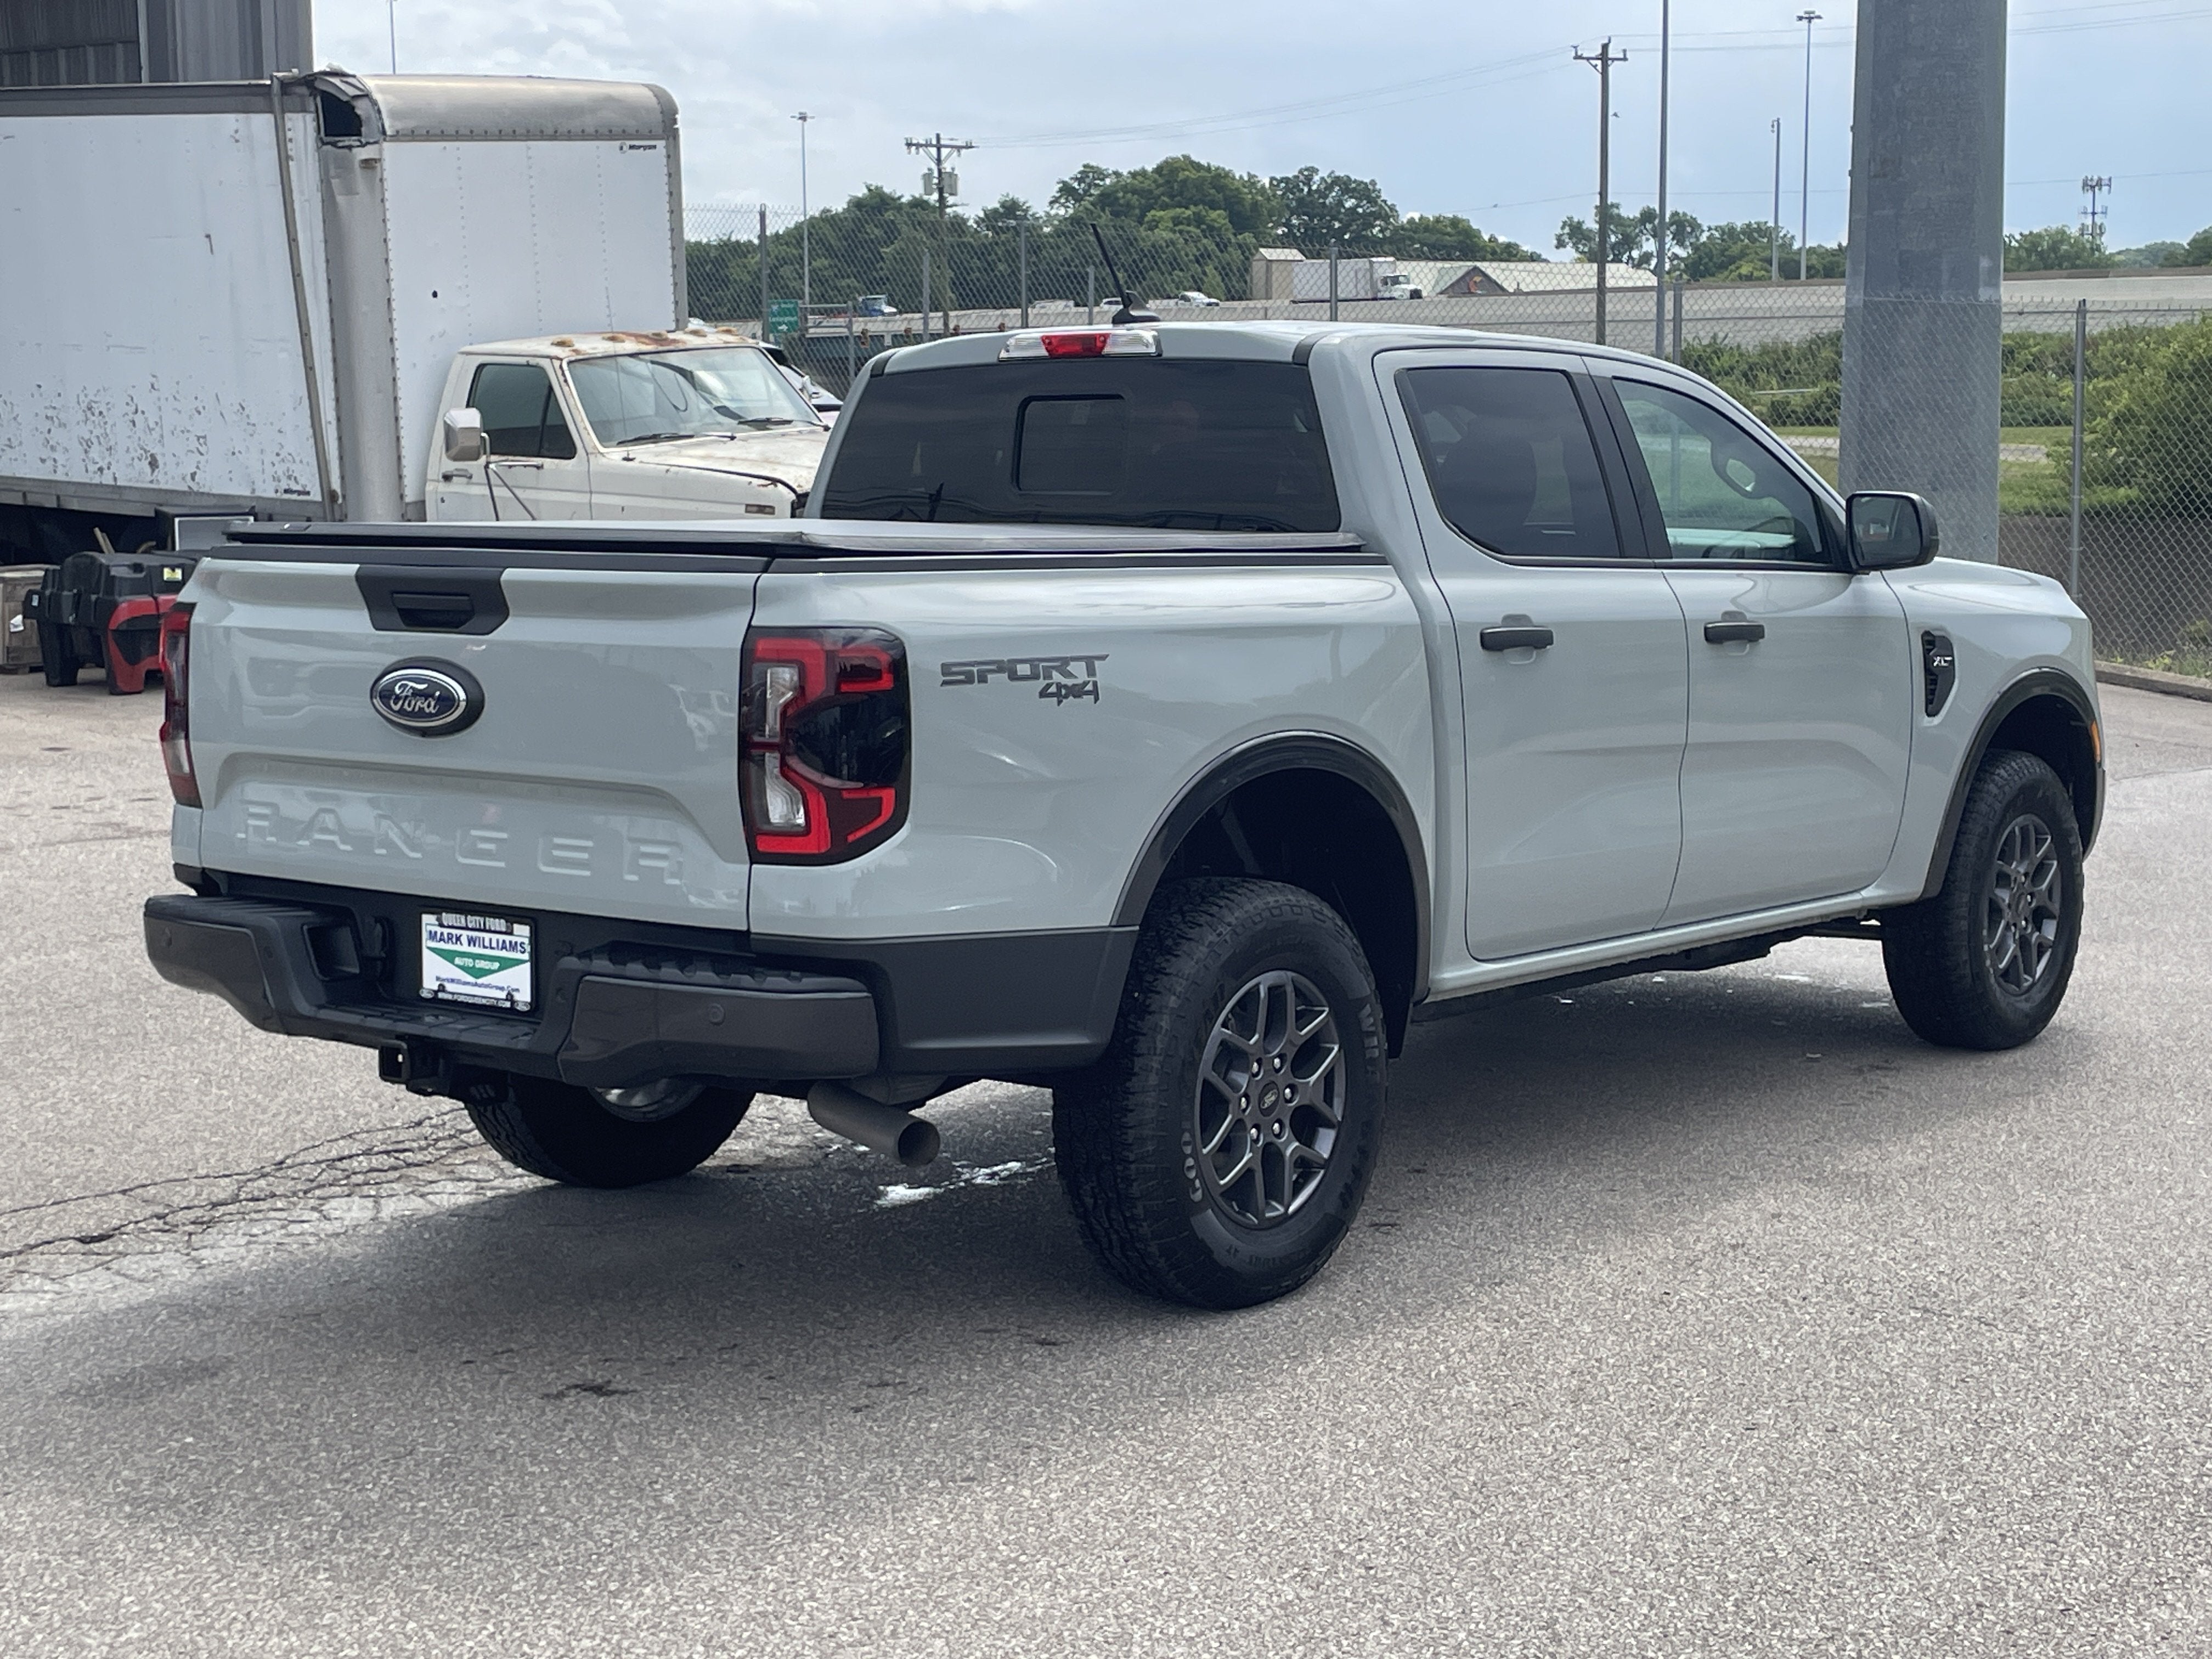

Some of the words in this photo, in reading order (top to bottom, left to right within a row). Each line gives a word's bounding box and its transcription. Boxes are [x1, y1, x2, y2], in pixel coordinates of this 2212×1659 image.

[940, 653, 1110, 687] SPORT
[1933, 656, 1953, 667] XLT
[390, 681, 441, 713] Ford
[236, 799, 684, 884] RANGER
[467, 915, 484, 930] CITY
[485, 917, 507, 932] FORD
[428, 930, 464, 947] MARK
[466, 934, 527, 955] WILLIAMS
[454, 956, 474, 968] AUTO
[475, 959, 500, 970] GROUP
